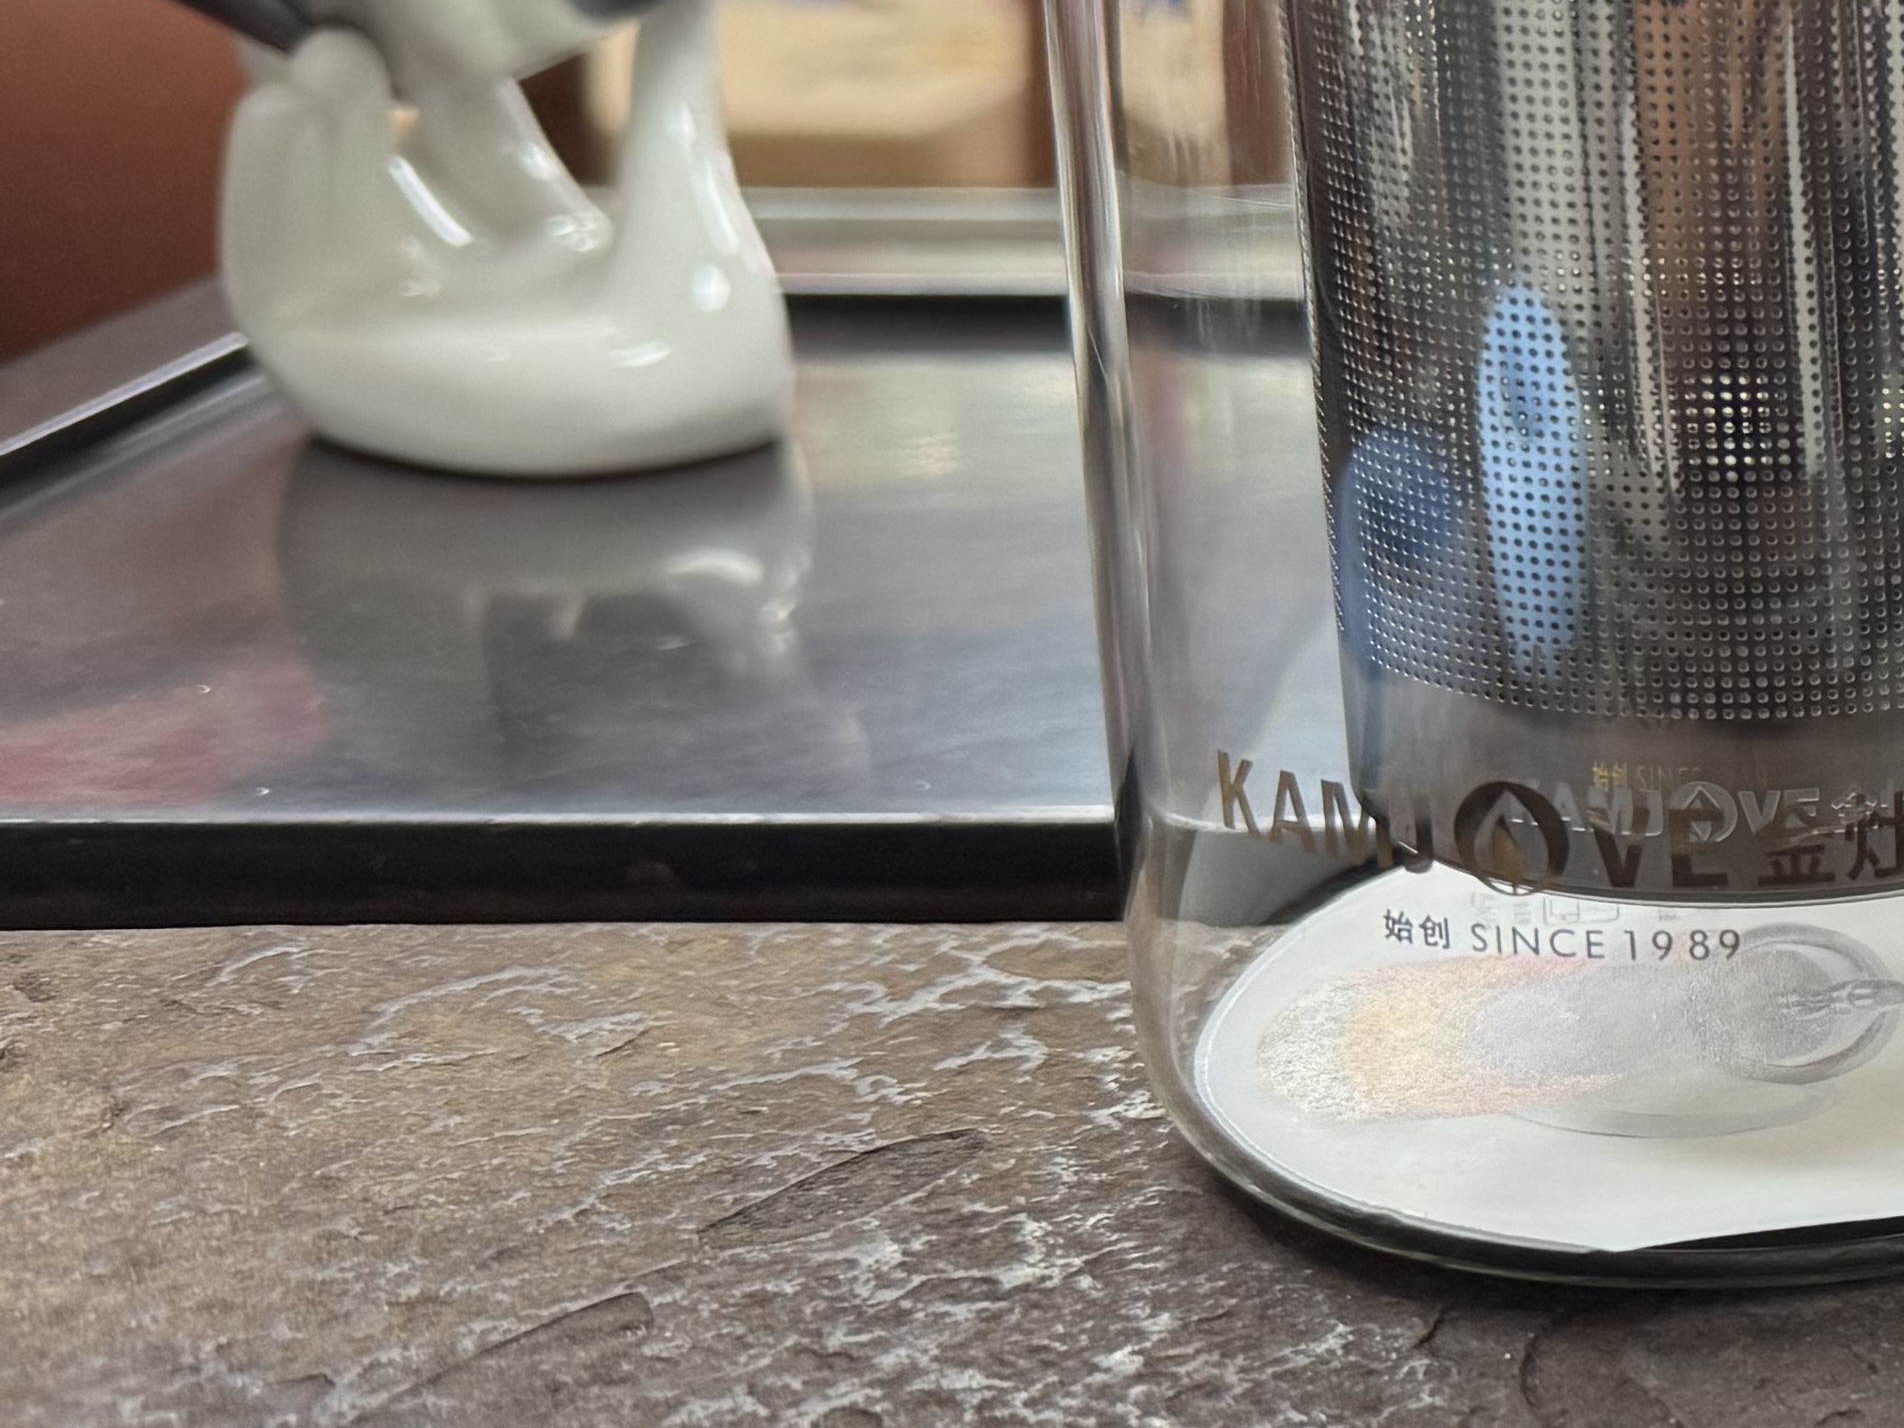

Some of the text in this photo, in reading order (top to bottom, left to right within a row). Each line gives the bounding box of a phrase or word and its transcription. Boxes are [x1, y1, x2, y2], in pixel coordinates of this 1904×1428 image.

[1217, 749, 1729, 896] KAMJOVE
[1384, 908, 1450, 950] 始创
[1471, 922, 1605, 960] SINCE
[1624, 929, 1741, 961] 1989
